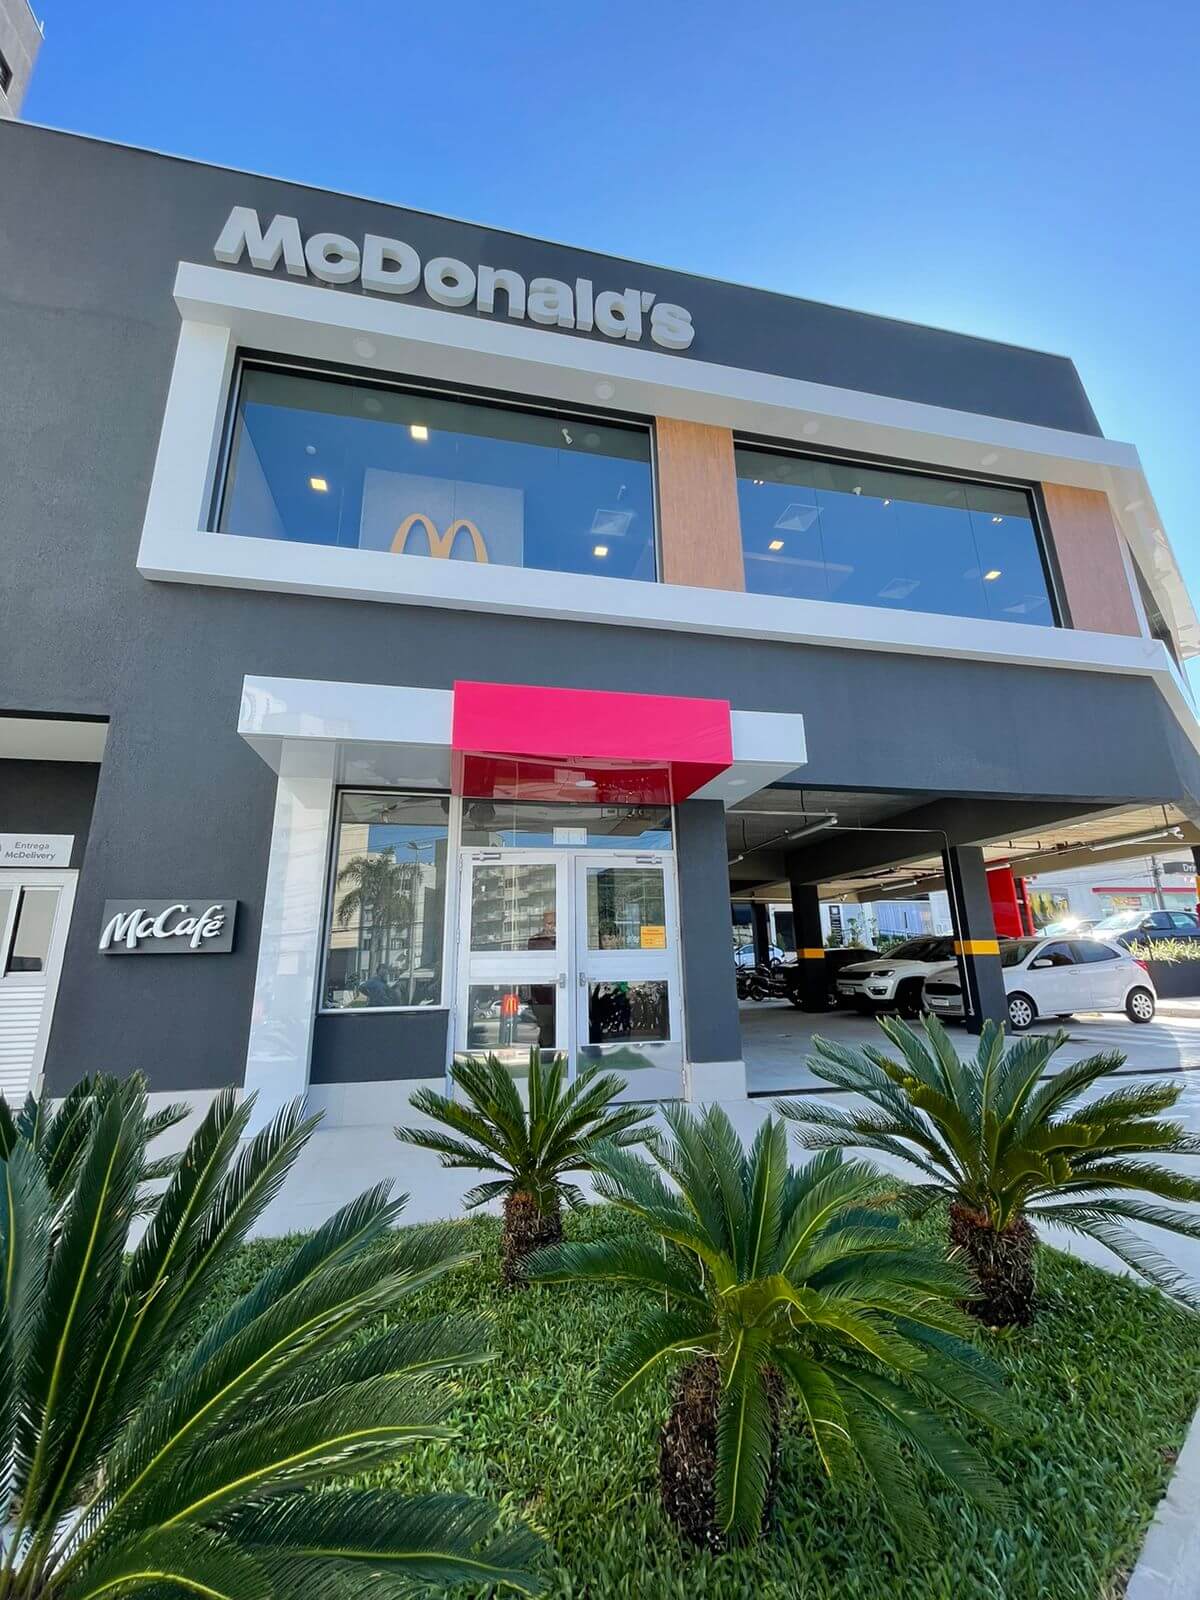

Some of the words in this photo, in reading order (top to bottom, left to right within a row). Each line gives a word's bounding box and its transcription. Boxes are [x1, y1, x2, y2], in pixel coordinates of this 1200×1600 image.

[213, 206, 695, 350] McDonald's
[4, 851, 56, 861] McDelivery
[14, 841, 50, 851] Entrega
[99, 904, 225, 949] McCafé
